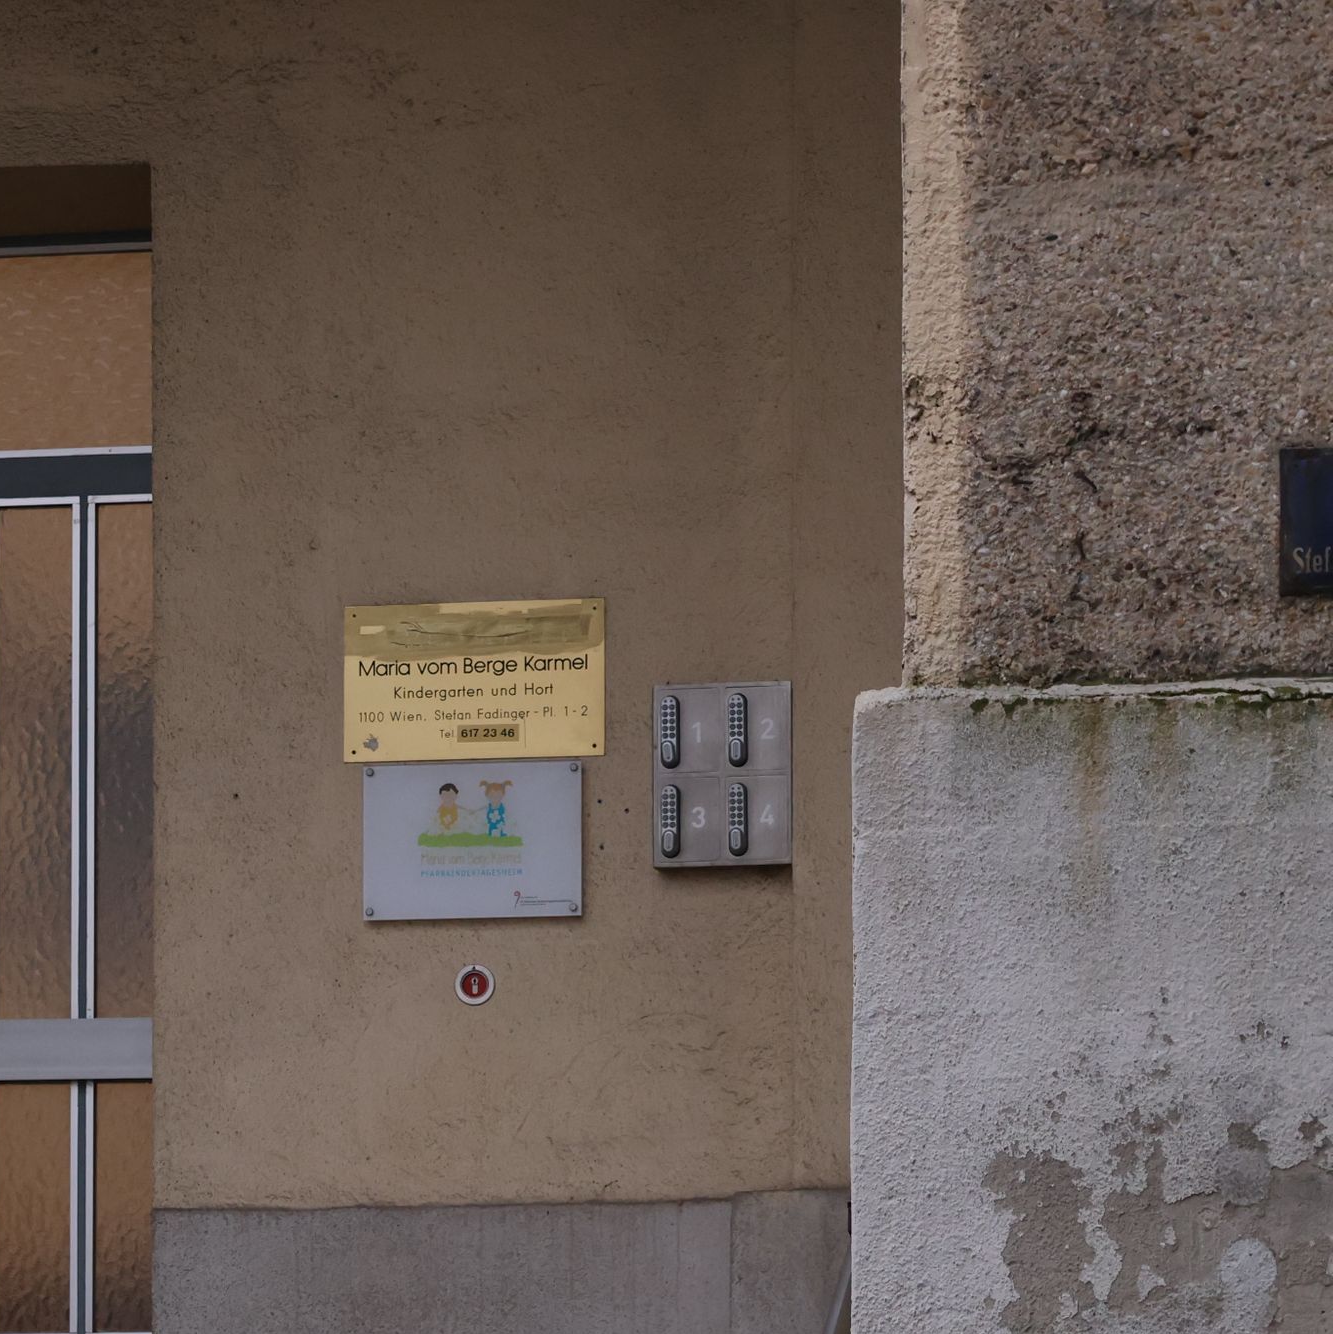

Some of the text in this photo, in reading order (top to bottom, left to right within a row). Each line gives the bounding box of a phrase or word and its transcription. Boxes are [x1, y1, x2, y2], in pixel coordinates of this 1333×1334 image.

[358, 653, 589, 677] Maria vom Berge Karmel
[394, 683, 554, 702] Kindergarten und Hort
[359, 711, 385, 723] 1100
[434, 709, 471, 721] Stefan
[460, 728, 480, 738] 617
[483, 728, 497, 738] 23
[500, 728, 515, 738] 46
[691, 721, 702, 743] 1
[760, 718, 776, 740] 2
[691, 806, 707, 829] 3
[759, 804, 776, 826] 4
